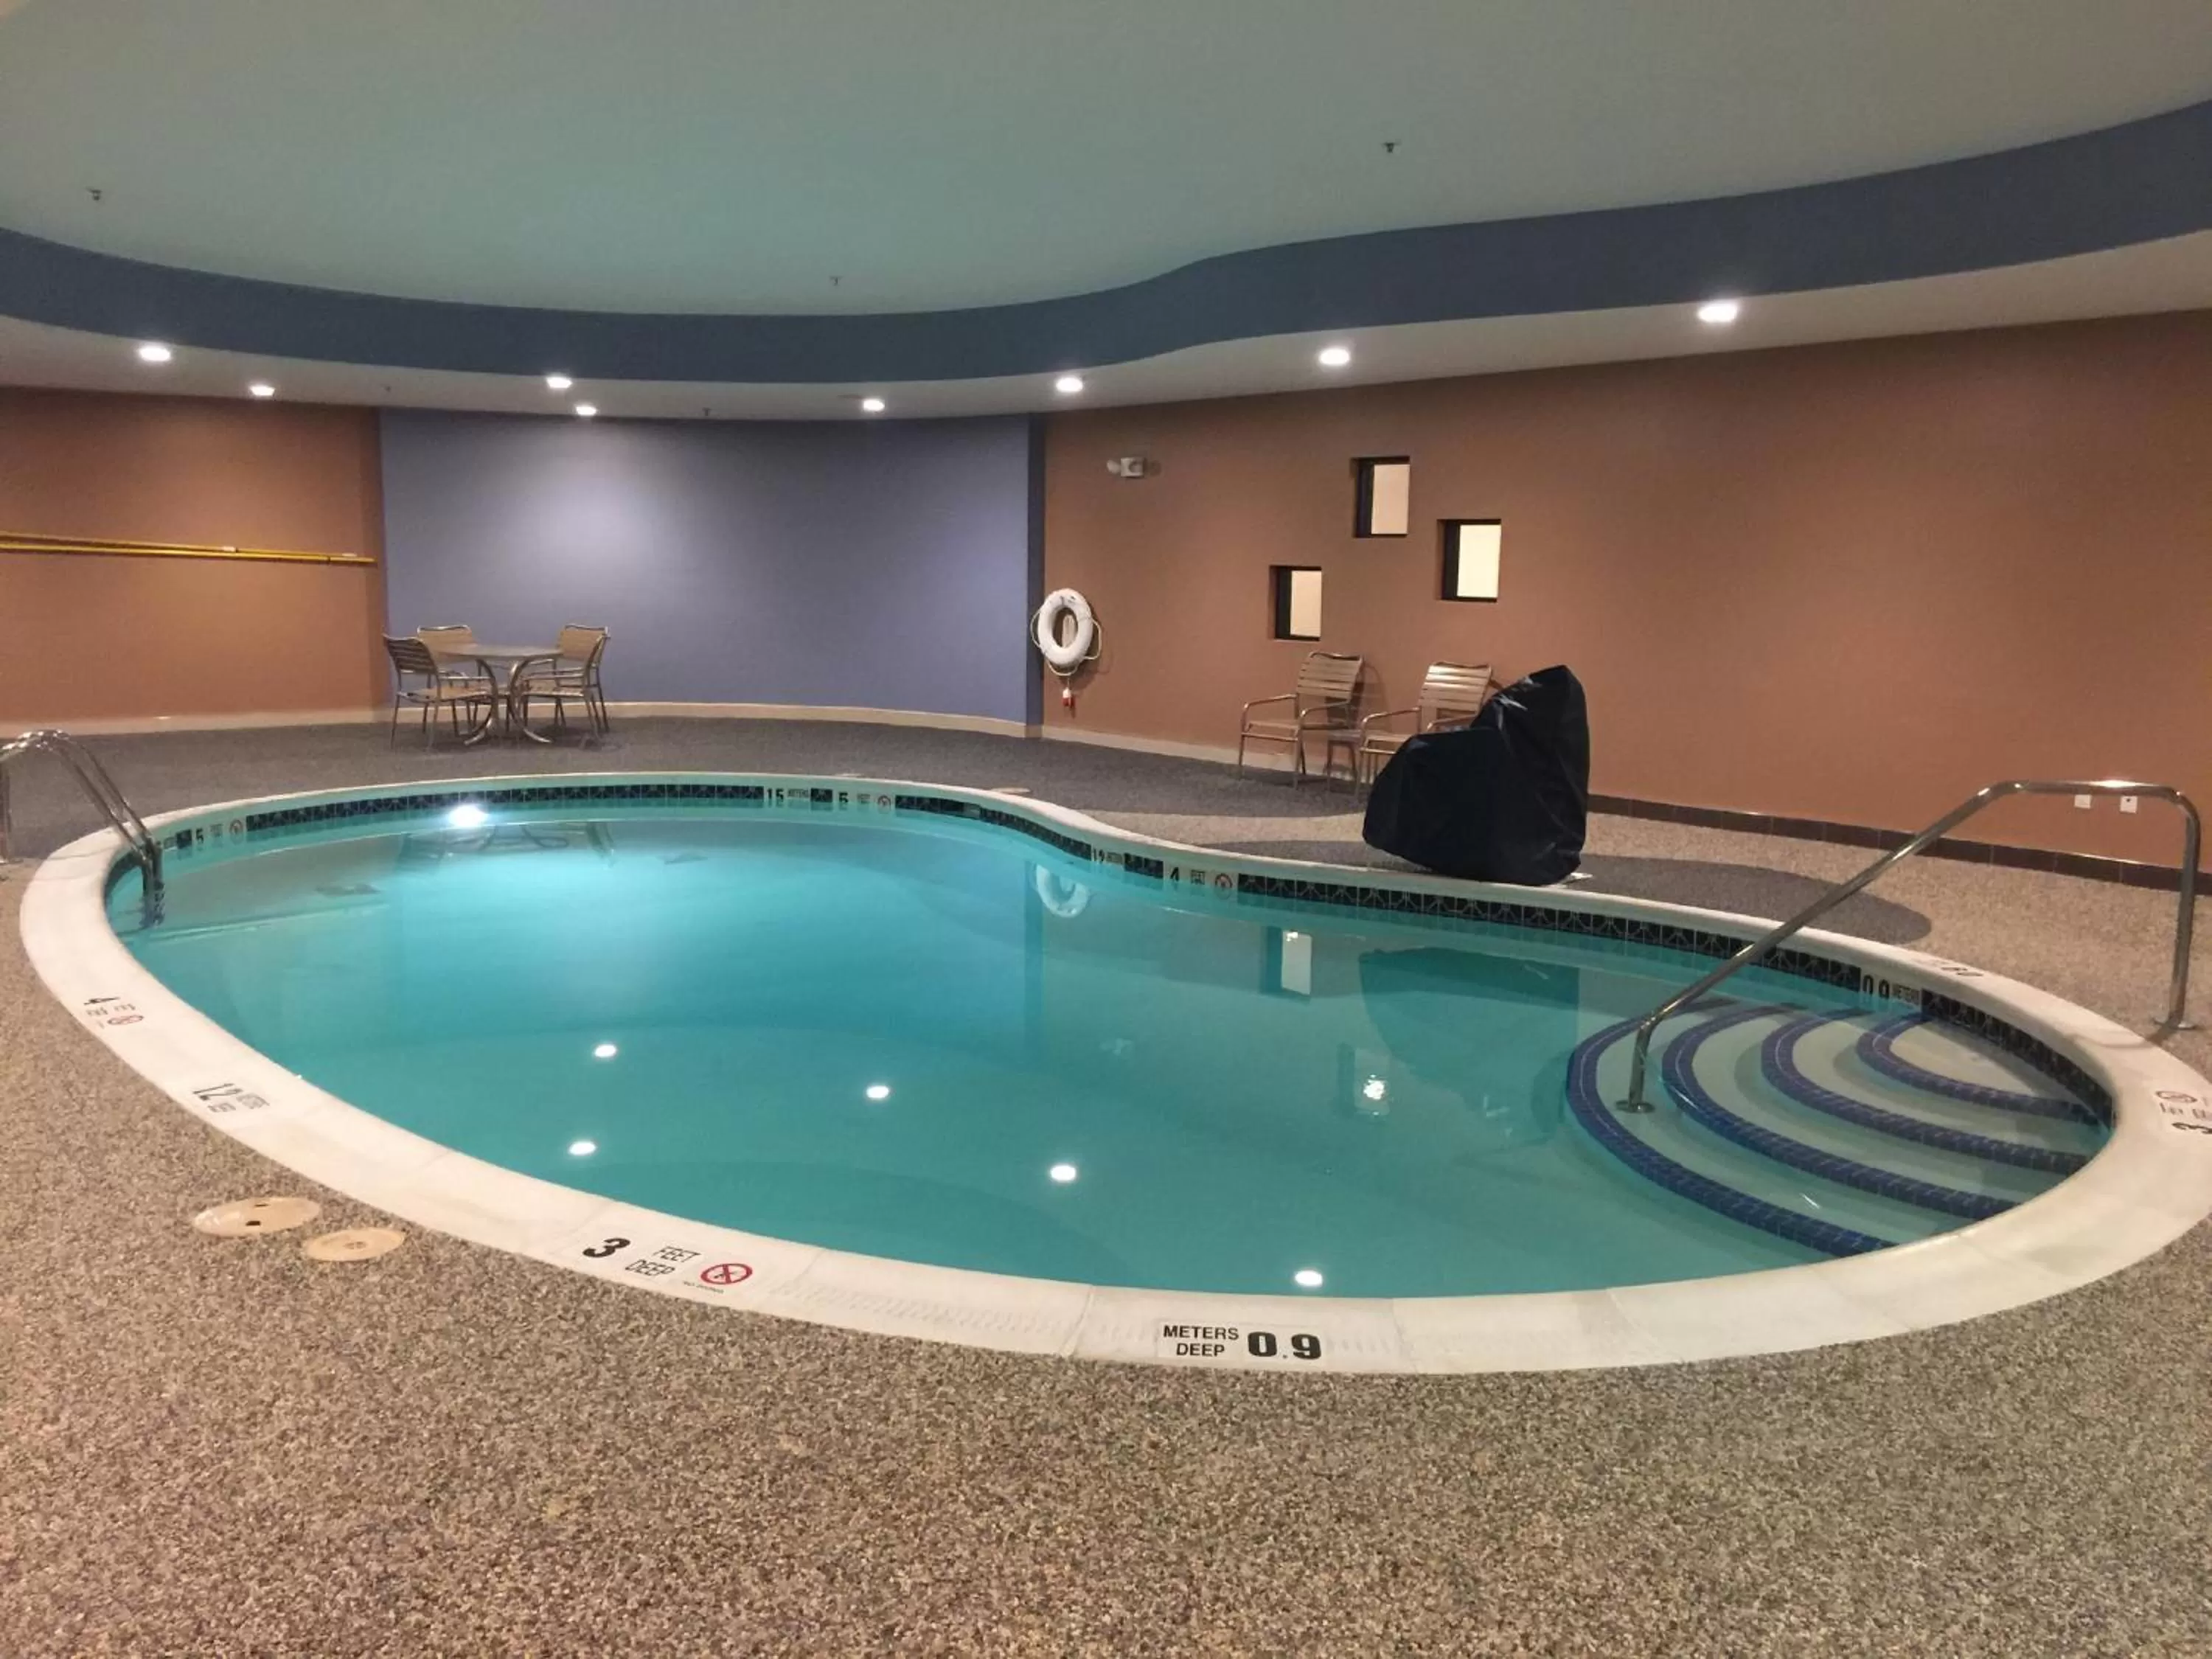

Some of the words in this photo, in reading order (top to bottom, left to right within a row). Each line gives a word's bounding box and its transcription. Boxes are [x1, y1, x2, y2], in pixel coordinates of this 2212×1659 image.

[582, 1238, 630, 1258] 3
[652, 1246, 701, 1262] FEET
[625, 1259, 676, 1276] DEEP
[1163, 1325, 1239, 1340] METERS
[1176, 1343, 1225, 1357] DEEP
[1248, 1332, 1322, 1360] 0.9
